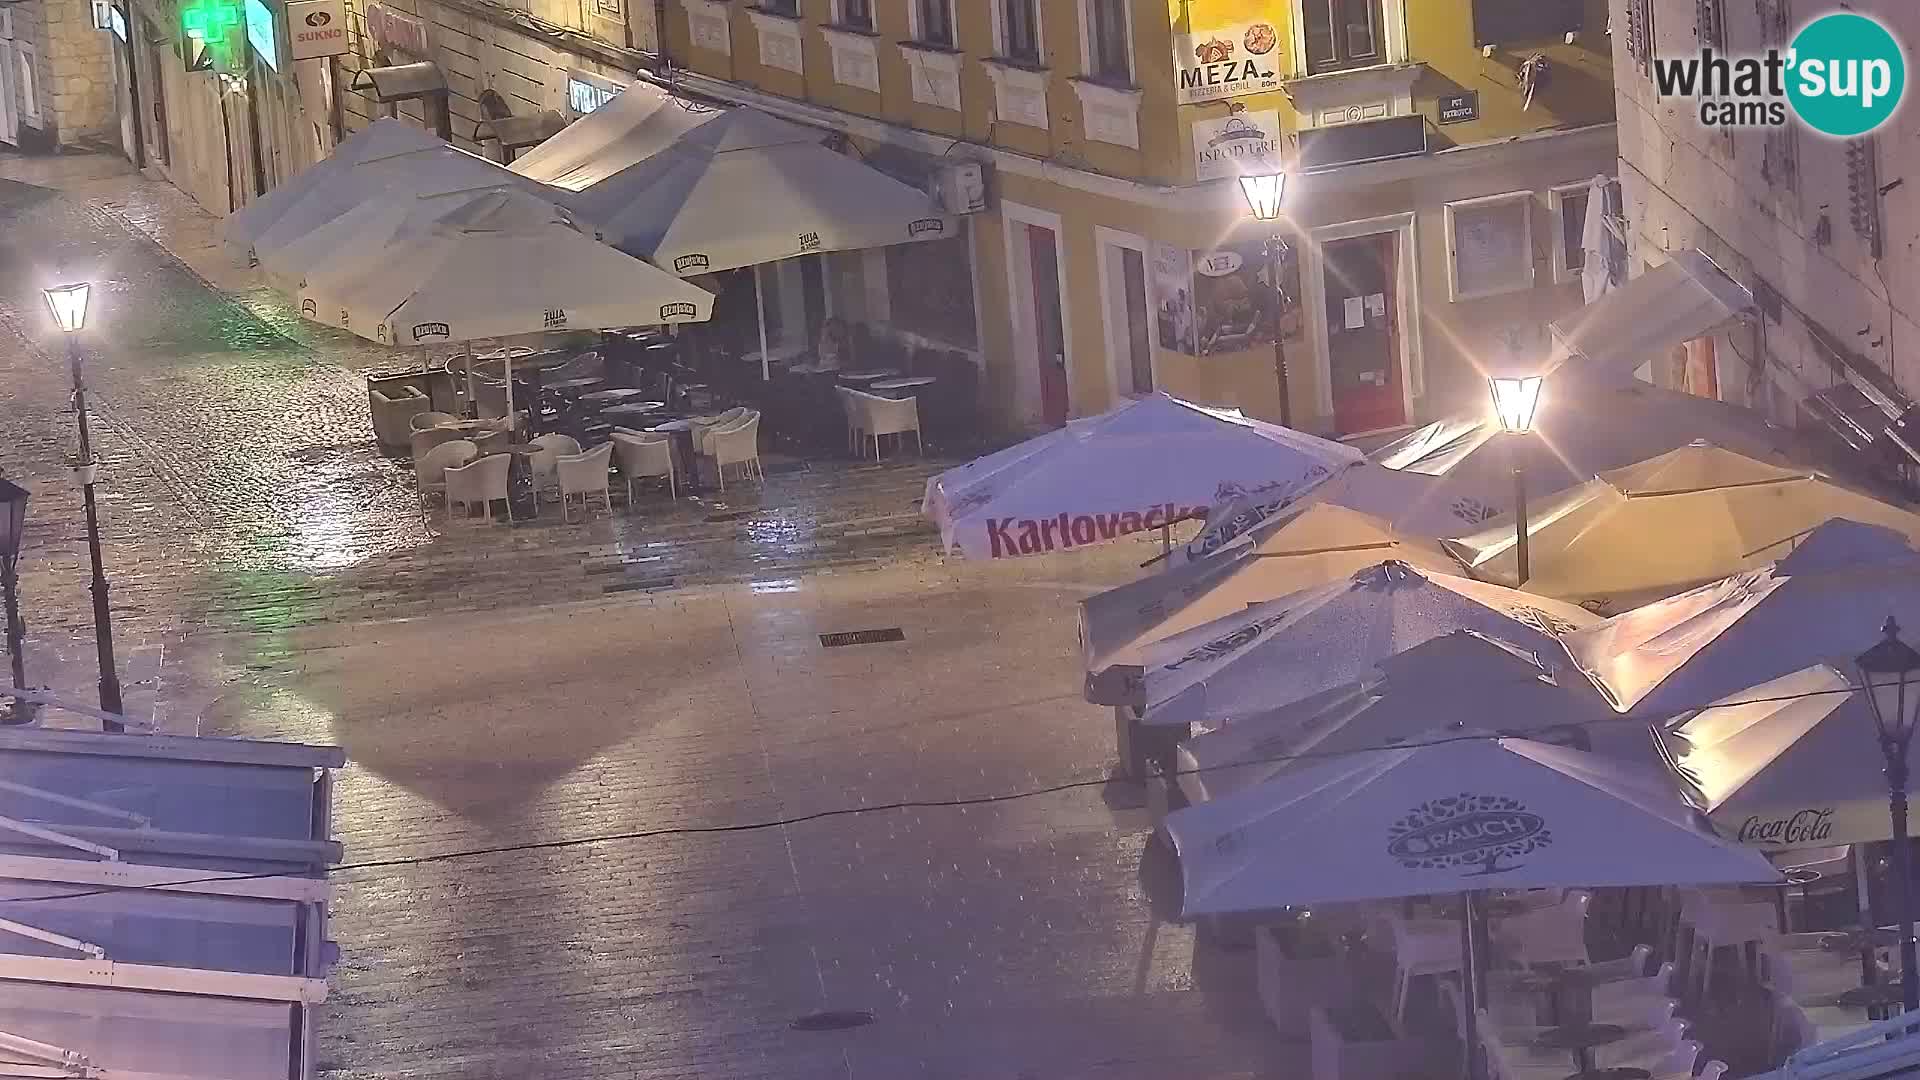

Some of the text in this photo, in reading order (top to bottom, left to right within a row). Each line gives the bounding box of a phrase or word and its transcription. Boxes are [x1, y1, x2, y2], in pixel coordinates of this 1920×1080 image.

[297, 28, 342, 42] SUKNO
[1180, 59, 1259, 90] MEZA
[1190, 86, 1222, 98] PIZZERIA
[1230, 81, 1251, 92] GRILL
[1199, 144, 1245, 162] ISPOD
[544, 308, 566, 321] ŽUJA
[1430, 815, 1526, 848] RAUCH
[1737, 808, 1834, 845] Coca-Cola
